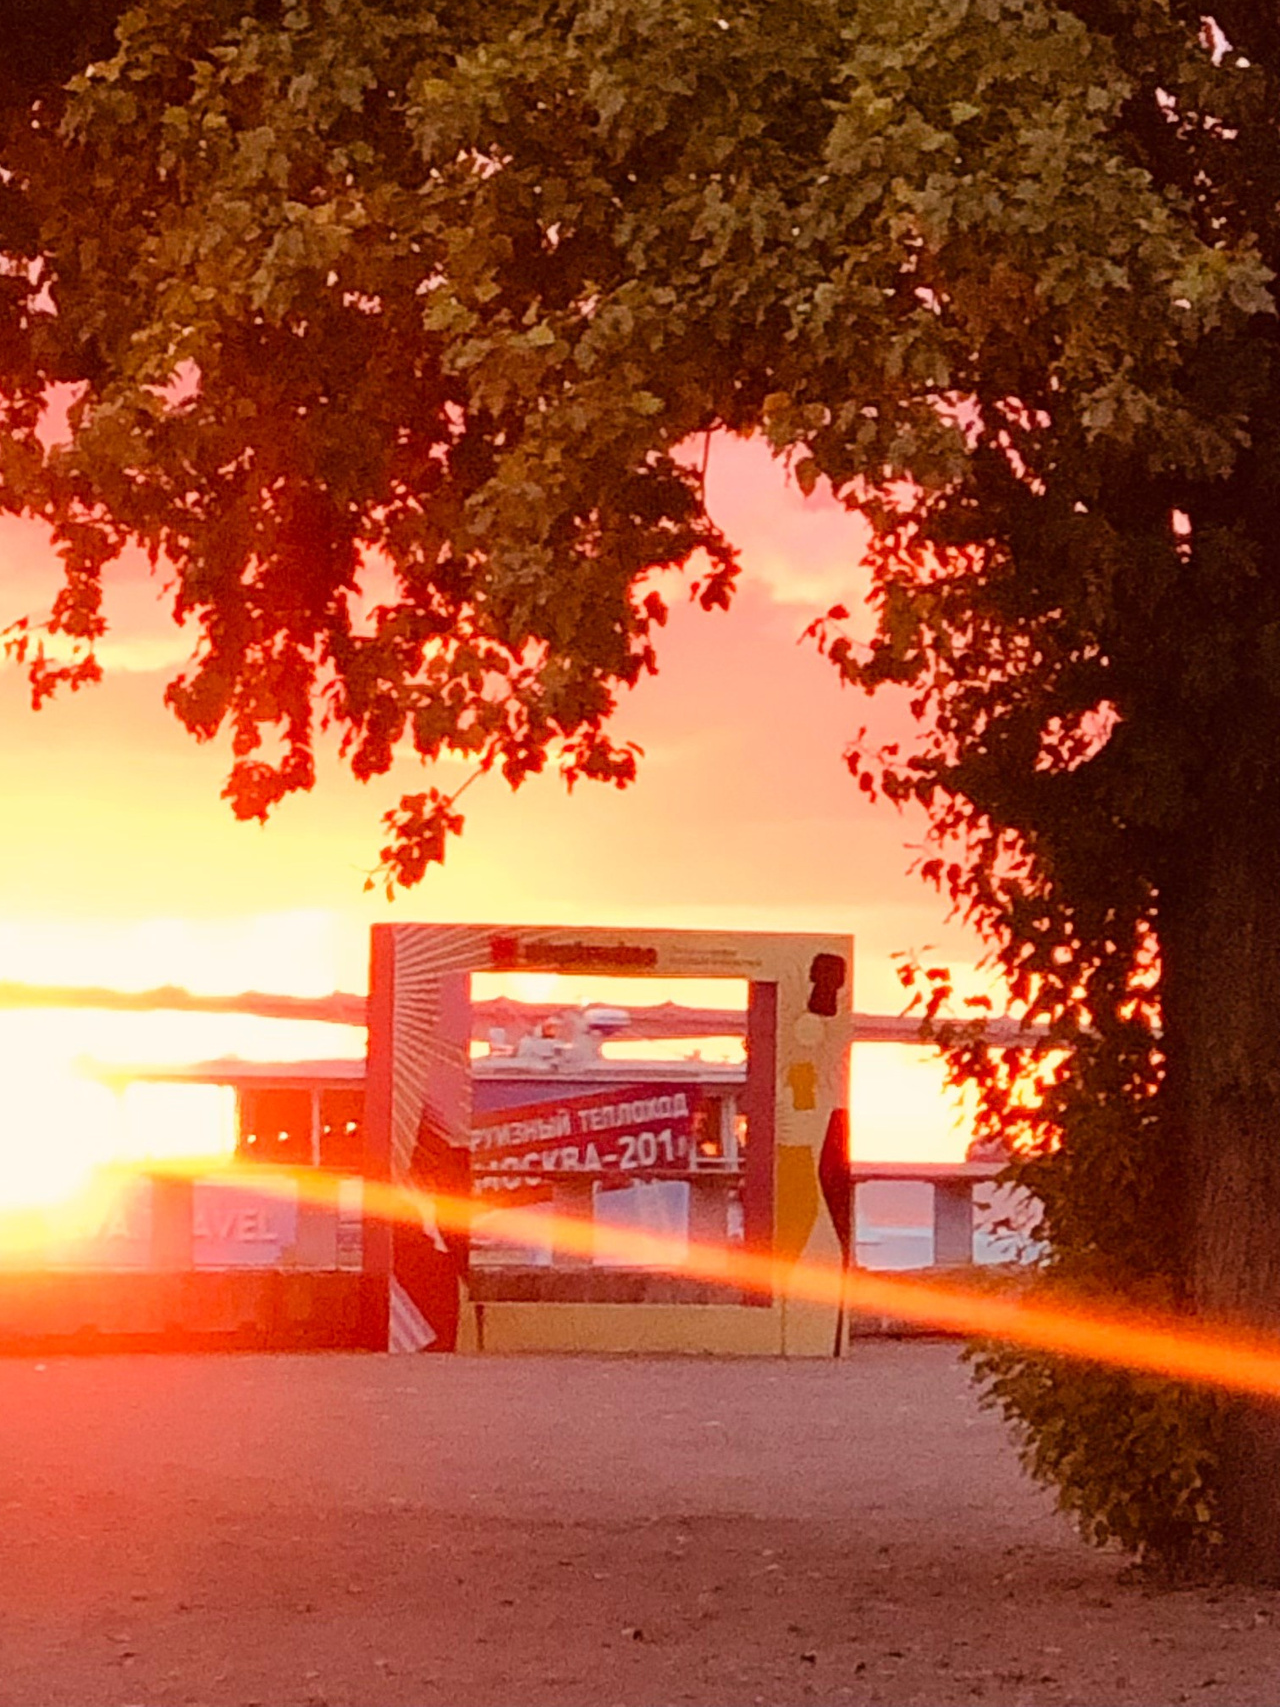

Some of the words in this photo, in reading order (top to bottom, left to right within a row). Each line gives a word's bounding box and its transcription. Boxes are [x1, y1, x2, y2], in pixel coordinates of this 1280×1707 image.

[471, 1109, 571, 1151] РУИЗНЫЙ
[578, 1093, 689, 1132] ТЕПЛОХОД
[194, 1209, 278, 1239] AVEL
